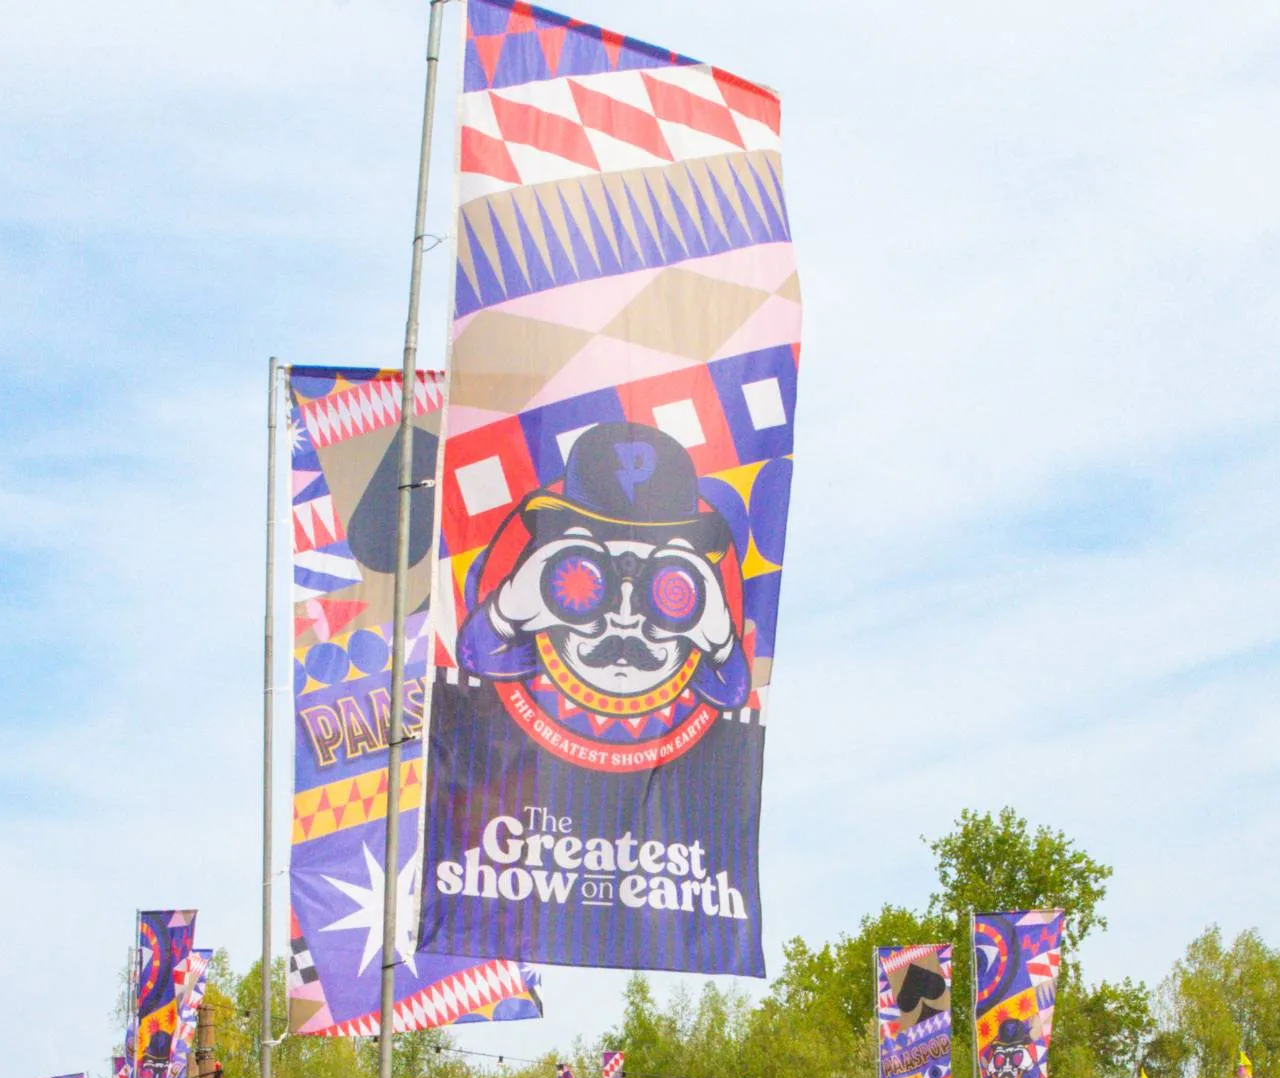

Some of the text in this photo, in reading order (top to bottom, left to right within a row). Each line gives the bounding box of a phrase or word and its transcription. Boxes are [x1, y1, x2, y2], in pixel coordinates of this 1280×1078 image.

[509, 689, 710, 767] THE GREATEST SHOW ON EARTH
[482, 815, 710, 880] Greatest
[523, 806, 573, 833] The
[436, 846, 749, 920] show on earth
[883, 1034, 950, 1078] PAASPOP
